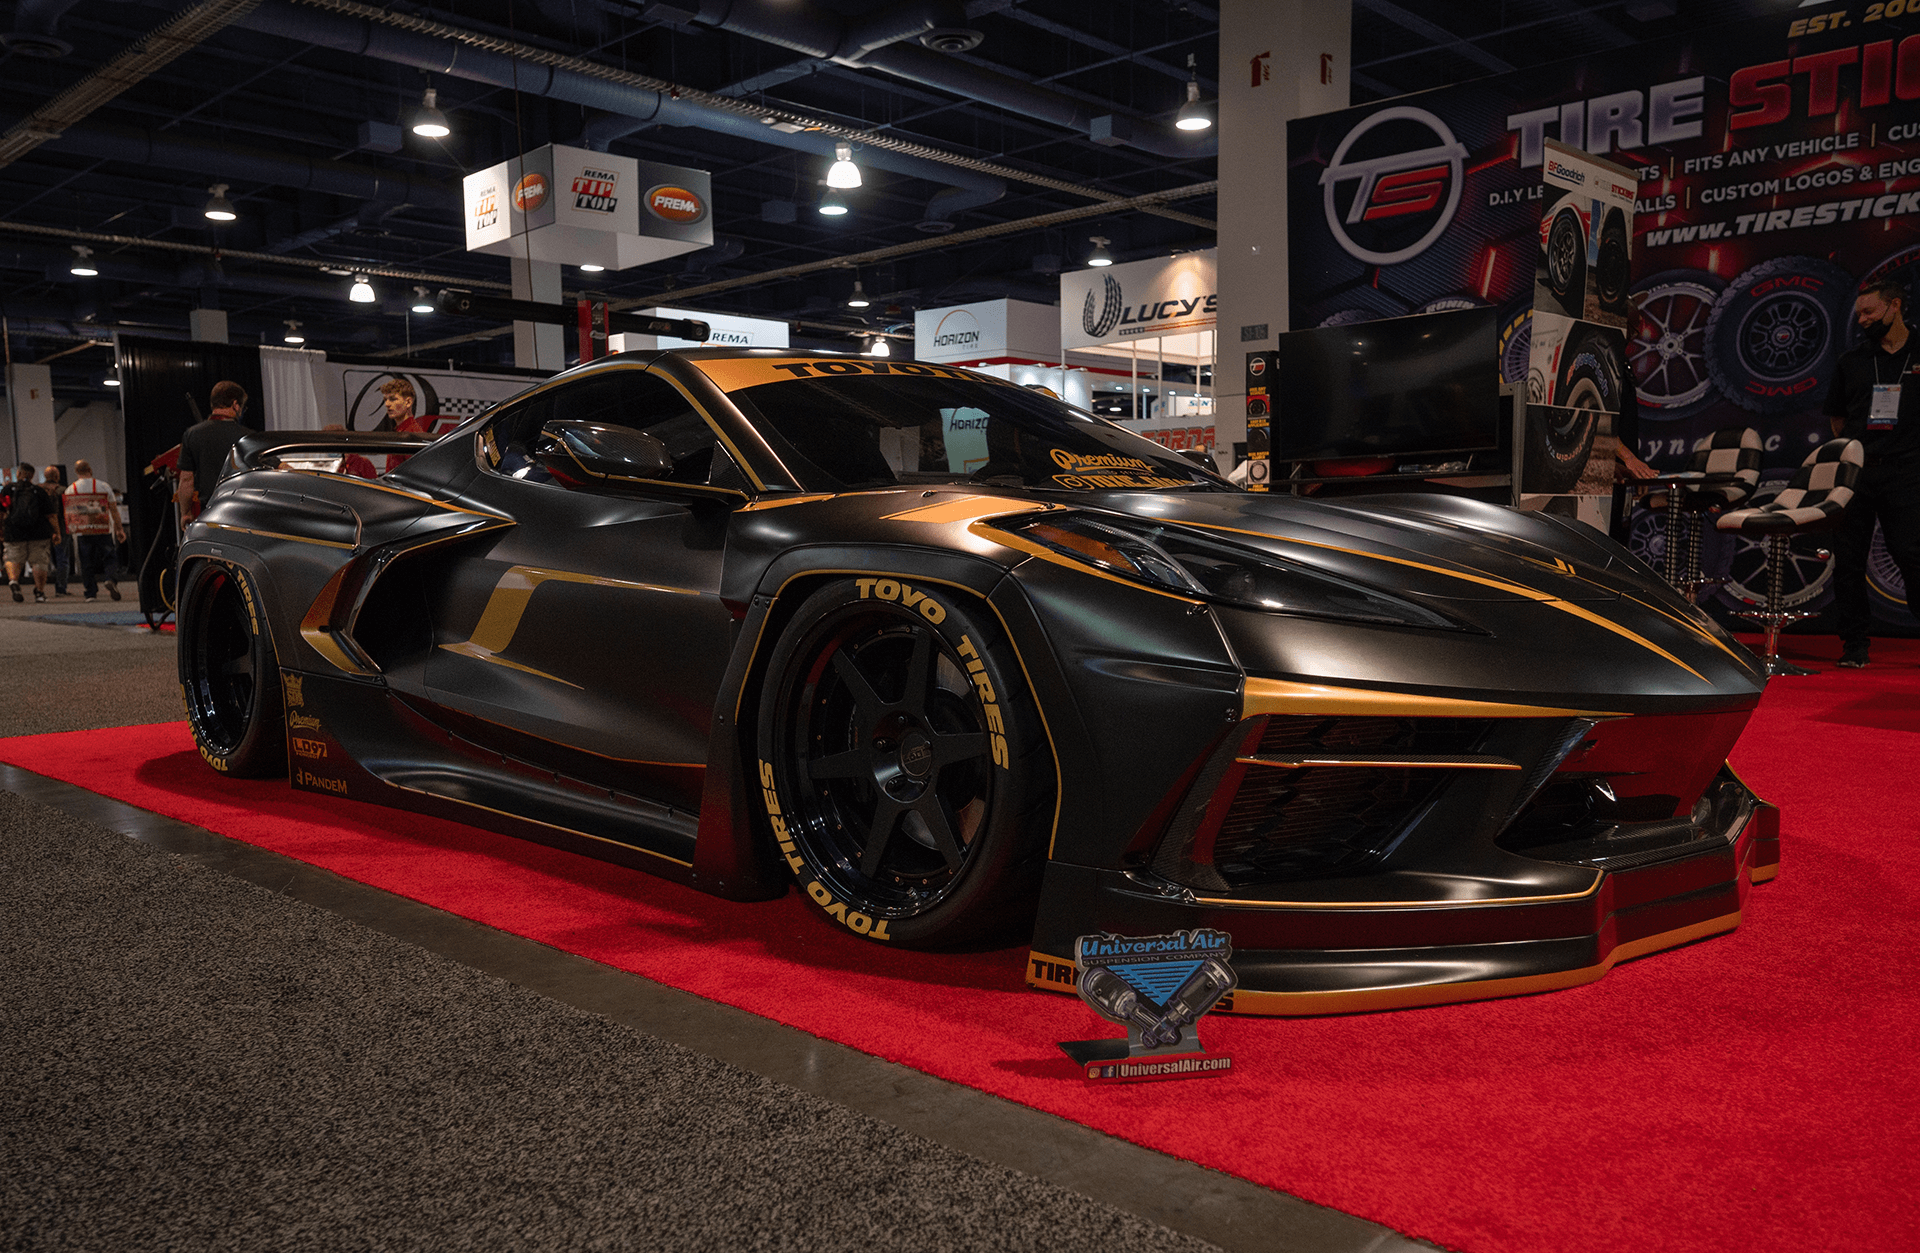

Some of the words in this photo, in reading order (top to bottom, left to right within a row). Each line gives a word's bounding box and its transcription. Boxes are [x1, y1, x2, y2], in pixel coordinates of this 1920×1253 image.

[1787, 10, 1852, 38] EST.
[1507, 75, 1705, 169] TIRE
[1684, 154, 1724, 174] FITS
[1728, 146, 1769, 168] ANY
[1774, 132, 1860, 160] VEHICLE
[1887, 122, 1920, 141] CU
[584, 169, 615, 181] REMA
[1548, 160, 1586, 183] BFGoodrich
[572, 177, 614, 198] TIP
[1700, 179, 1780, 204] CUSTOM
[1784, 169, 1854, 192] LOGOS
[1859, 165, 1873, 181] &
[577, 193, 618, 213] TOP
[654, 195, 697, 213] PREMA
[1489, 188, 1524, 206] D.I.Y
[1750, 276, 1825, 298] GMC
[1119, 294, 1217, 325] LUCY'S
[712, 332, 749, 344] REMA
[933, 330, 980, 347] HORIZON
[772, 361, 937, 378] TOYO
[1745, 377, 1819, 397] GMC
[855, 577, 948, 626] TOYO
[956, 633, 1010, 771] TIRES
[758, 758, 806, 876] TIRES
[807, 880, 892, 941] TOYO
[1082, 935, 1188, 956] Universal
[1191, 933, 1226, 949] Air
[1083, 955, 1160, 966] SUSPENSION
[1165, 951, 1227, 961] COMPANY
[1120, 1057, 1231, 1077] UniversalAir.com
